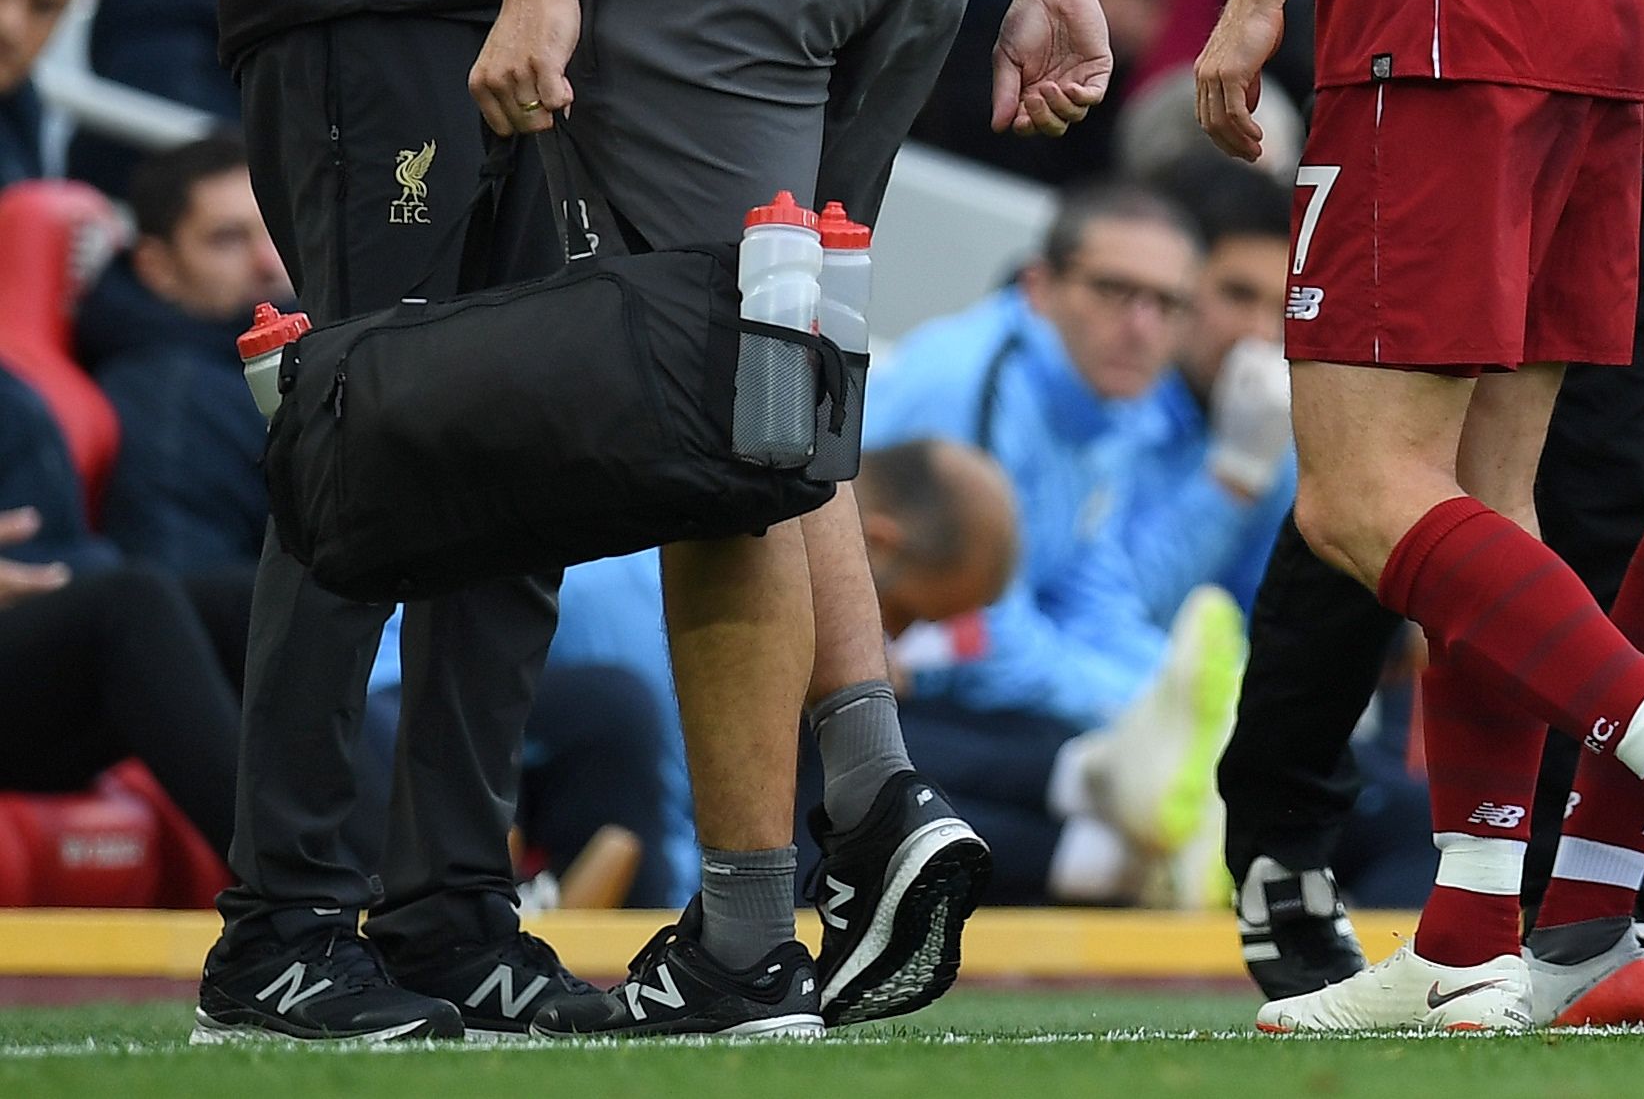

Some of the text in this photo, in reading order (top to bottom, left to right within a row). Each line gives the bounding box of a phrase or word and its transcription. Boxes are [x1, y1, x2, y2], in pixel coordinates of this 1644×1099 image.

[1293, 166, 1341, 275] 7
[255, 961, 334, 1015] N
[464, 964, 550, 1019] N
[625, 963, 686, 1021] N
